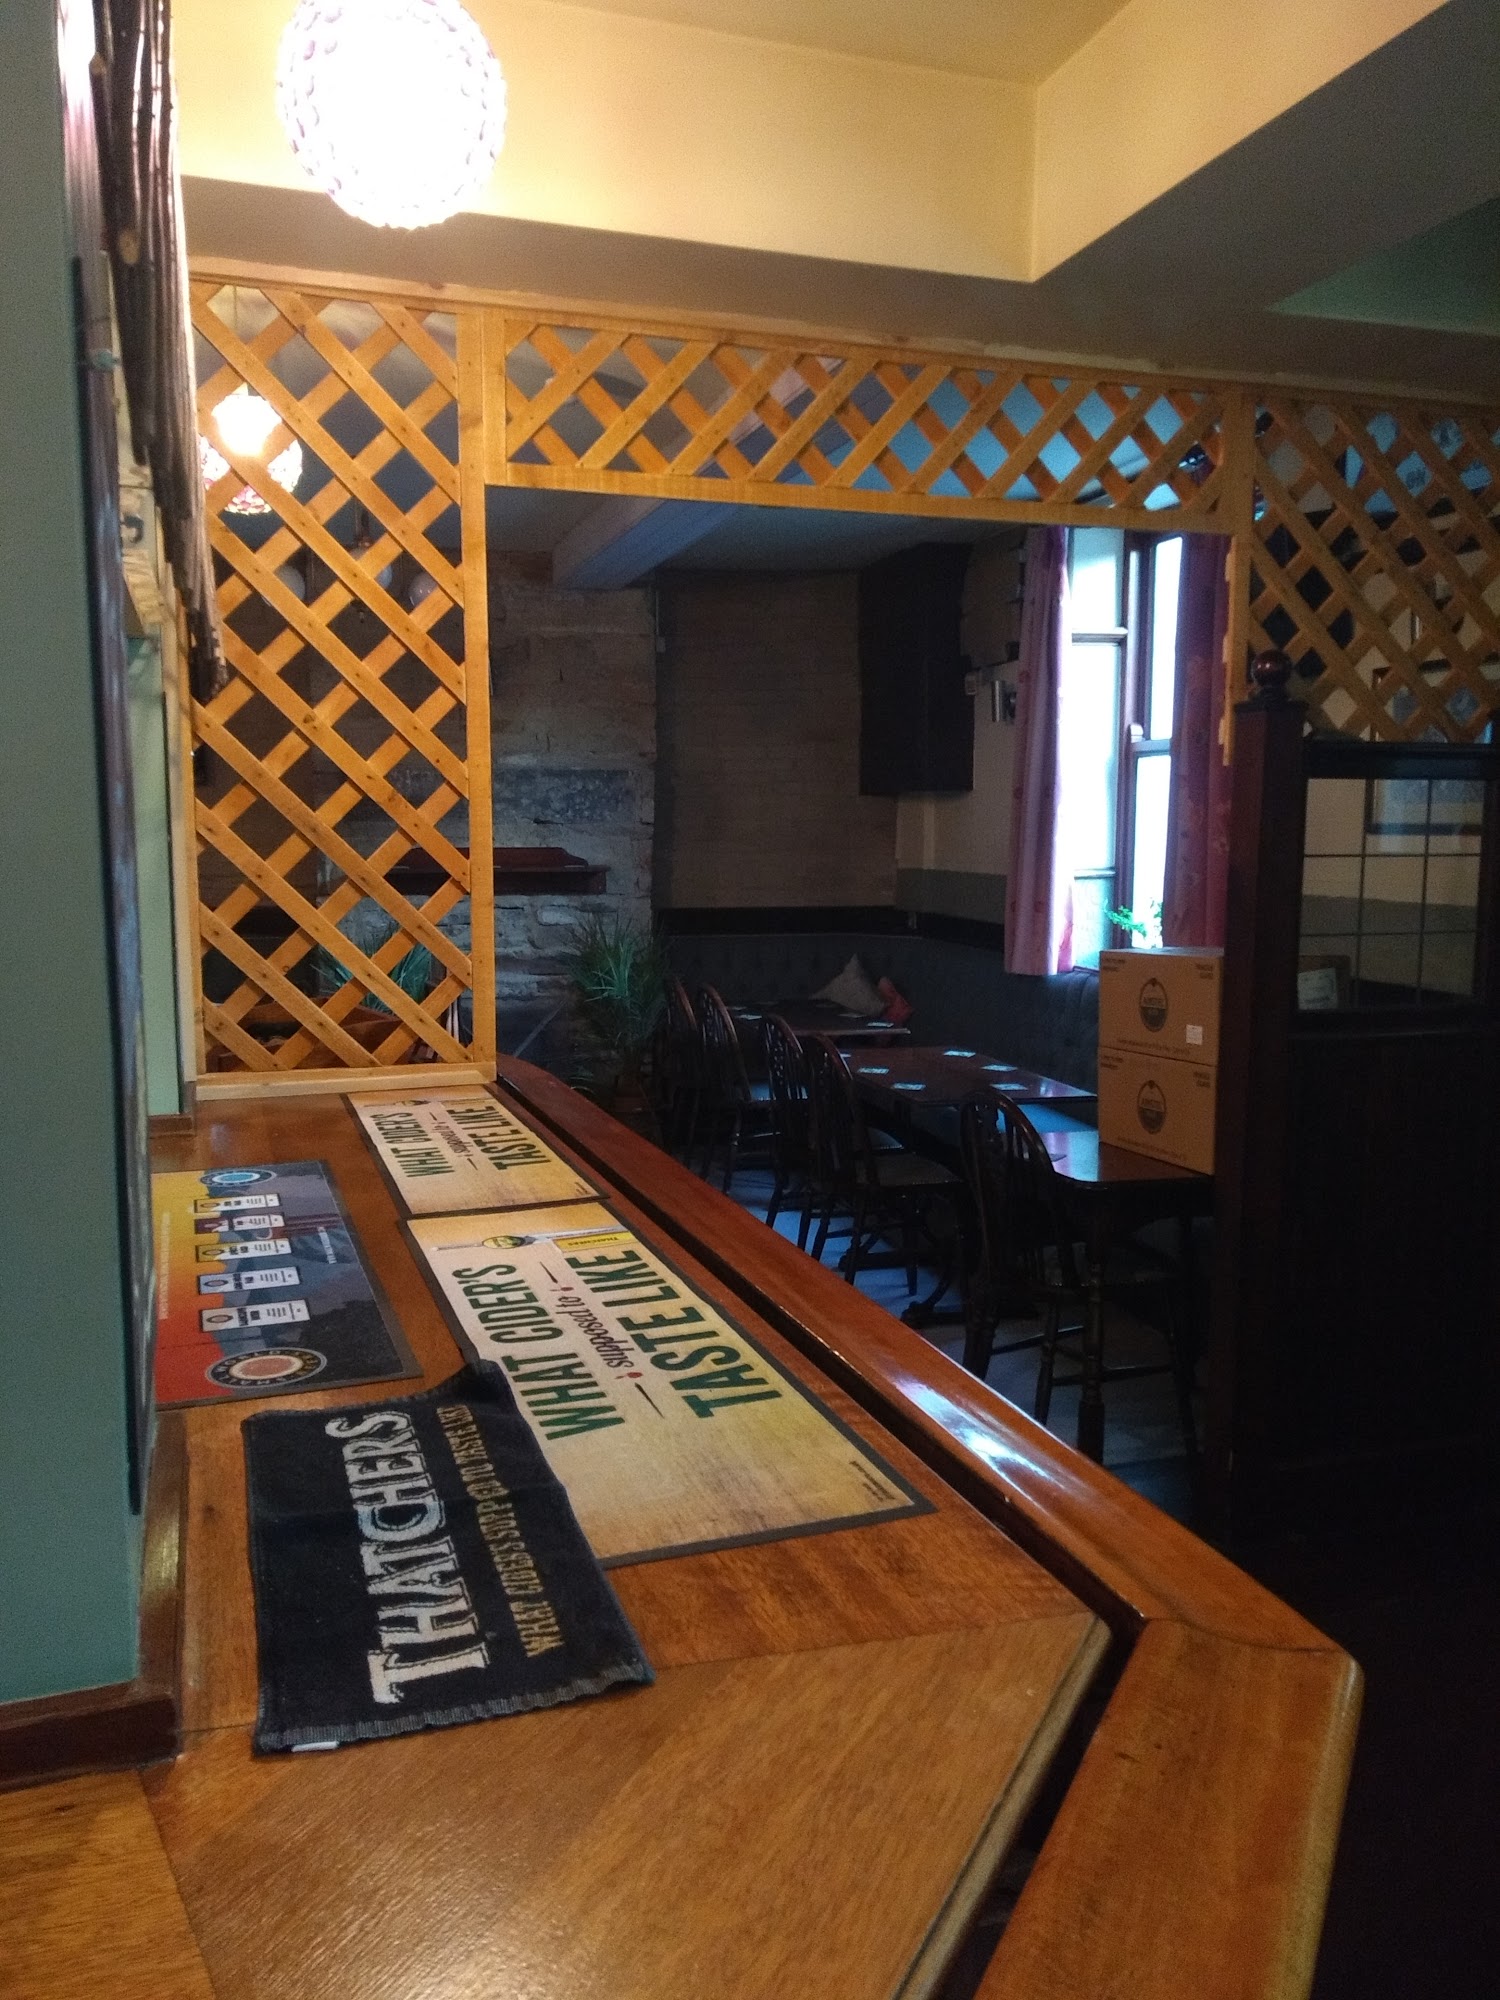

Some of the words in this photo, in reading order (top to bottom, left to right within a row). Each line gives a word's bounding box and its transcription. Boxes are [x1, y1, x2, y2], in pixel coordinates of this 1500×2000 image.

[370, 1112, 432, 1144] CIDER'S
[446, 1105, 512, 1130] LIKE
[390, 1146, 455, 1178] WHAT
[442, 1129, 474, 1157] supposed
[468, 1129, 551, 1170] TASTE
[564, 1250, 680, 1307] LIKE
[452, 1263, 563, 1344] CIDER'S
[556, 1296, 582, 1315] to
[568, 1308, 635, 1369] supposed
[616, 1306, 782, 1418] TASTE
[501, 1352, 625, 1440] WHAT
[444, 1424, 488, 1464] TASTE
[460, 1462, 495, 1481] TO
[325, 1411, 489, 1704] THATCHERS
[488, 1541, 544, 1595] CIDER'S
[510, 1600, 565, 1658] WHAT
